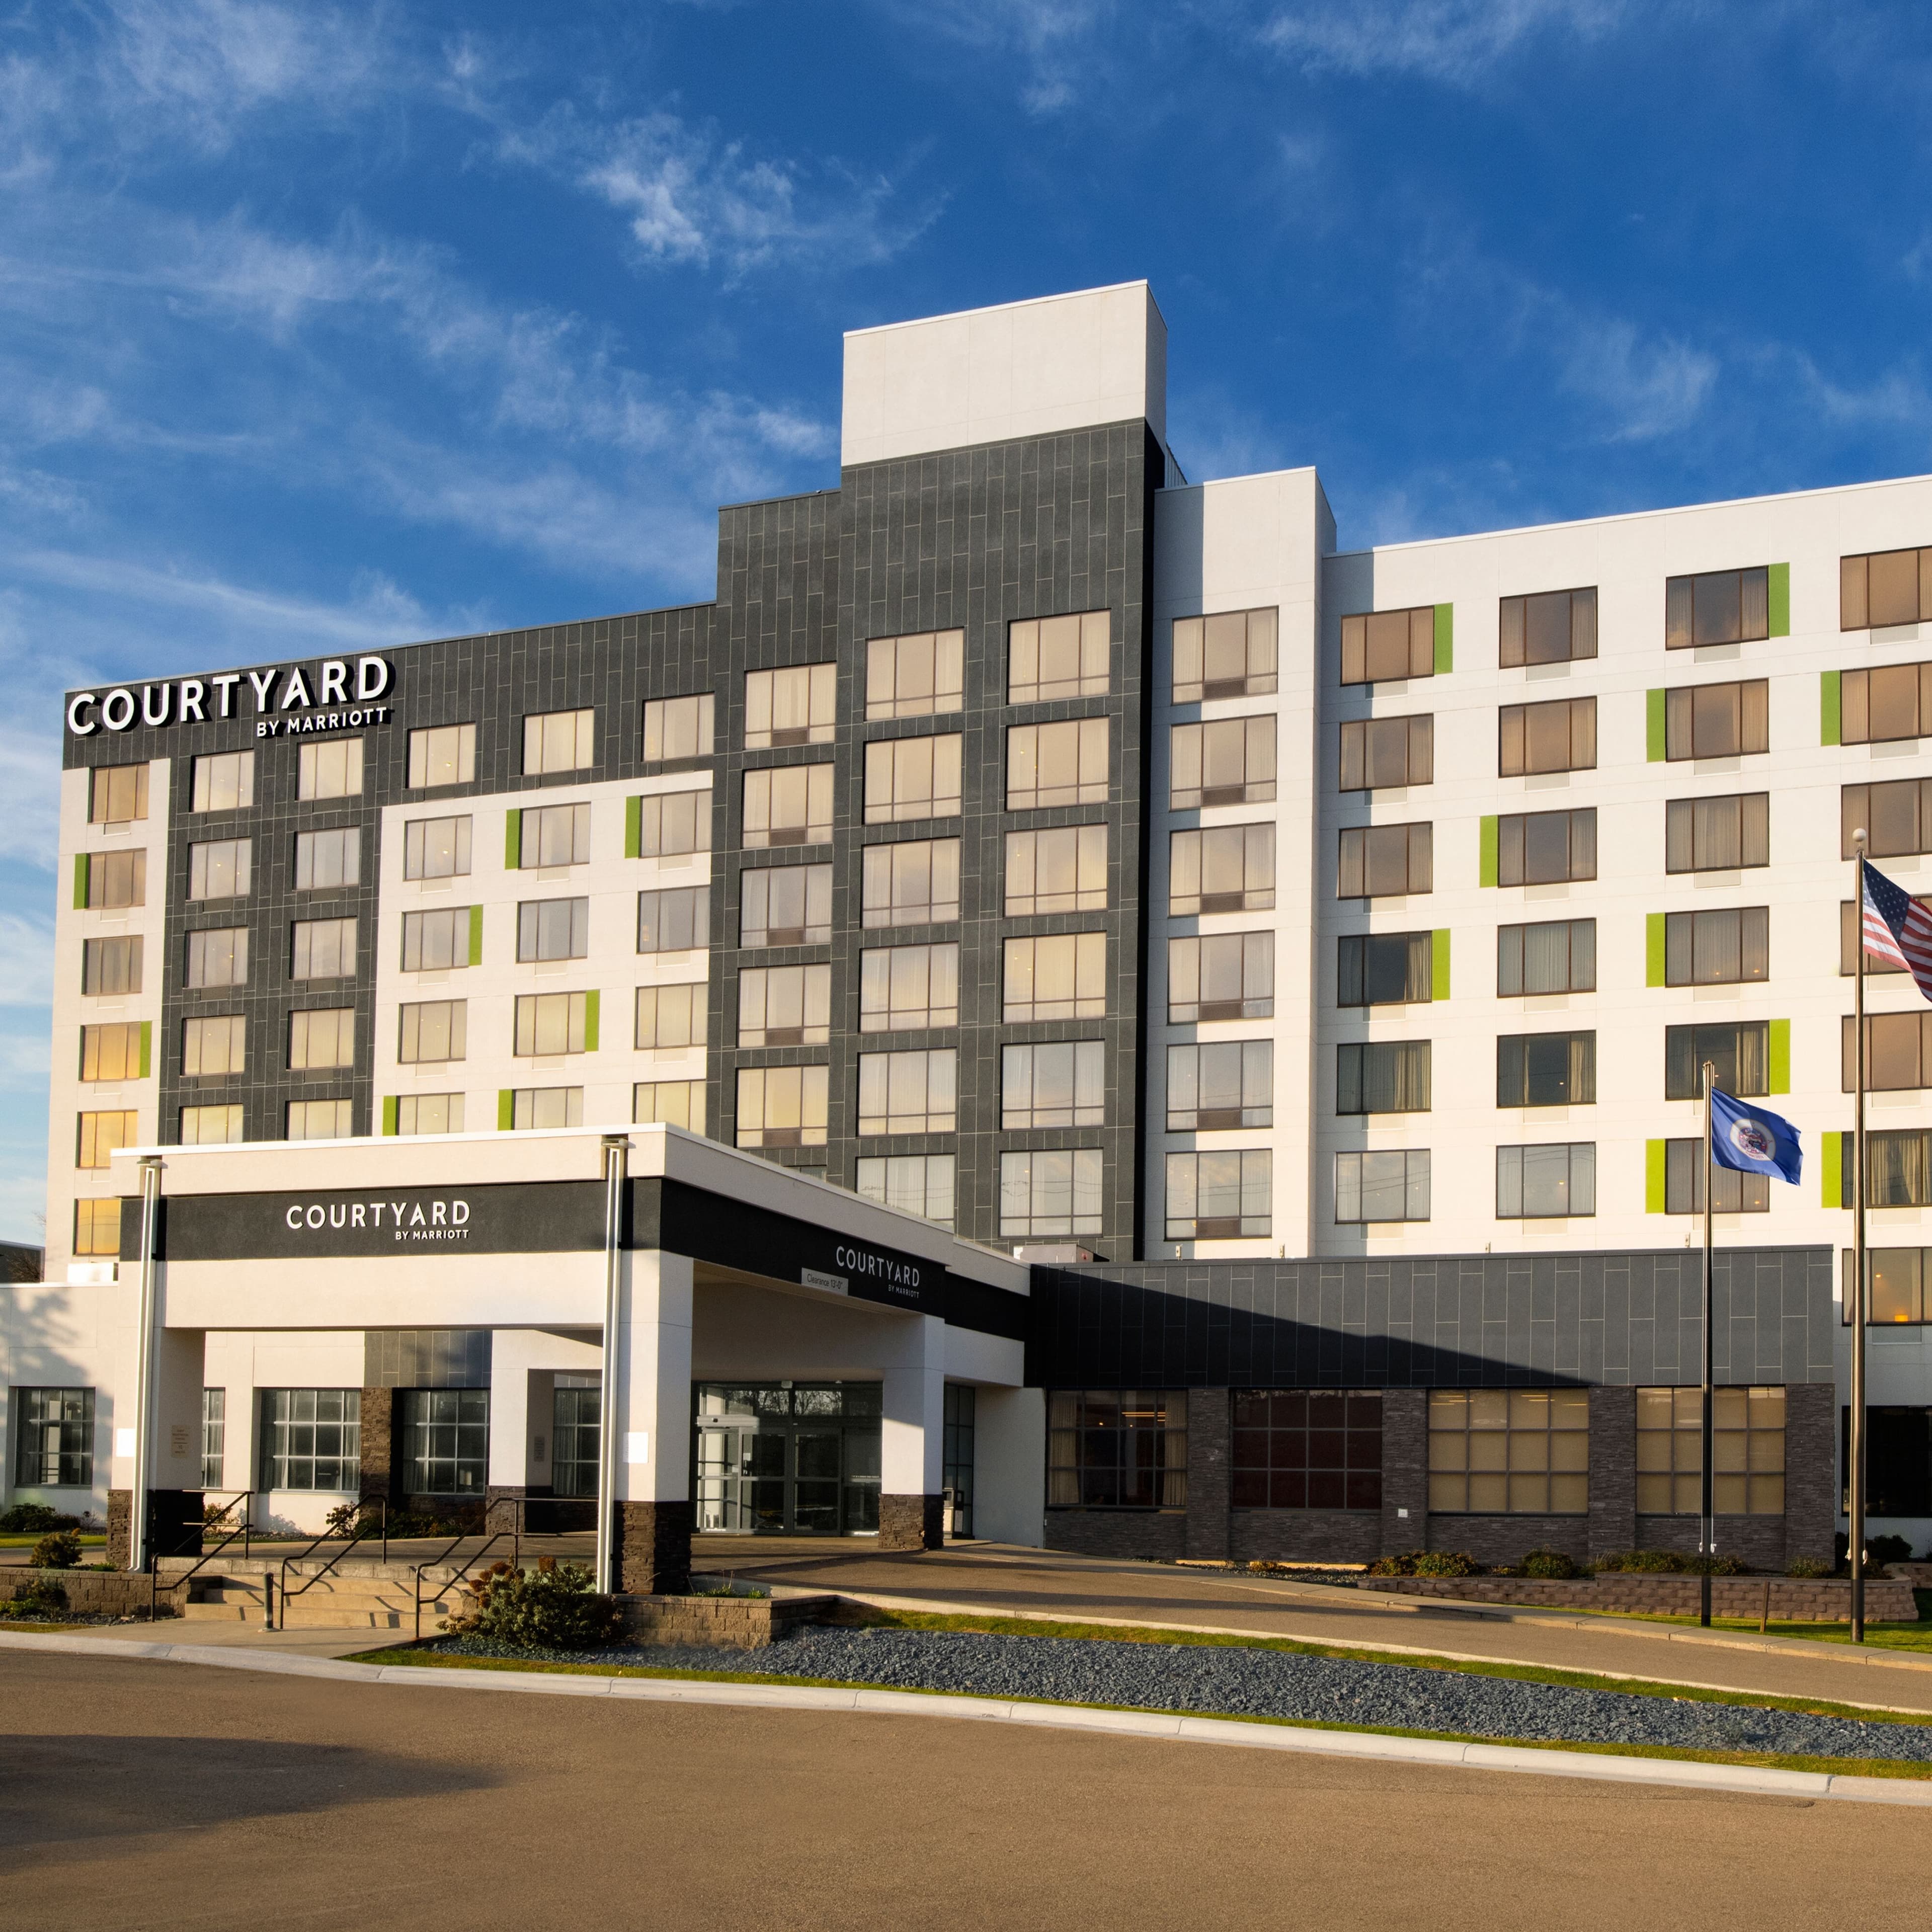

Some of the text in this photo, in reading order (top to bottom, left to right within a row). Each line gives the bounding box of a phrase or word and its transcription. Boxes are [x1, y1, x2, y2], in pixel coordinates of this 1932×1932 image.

[68, 656, 388, 735] COURTYARD
[257, 706, 387, 737] BY MARRIOTT
[286, 1200, 470, 1229] COURTYARD
[395, 1229, 469, 1240] BY MARRIOTT
[807, 1273, 830, 1286] Clearance
[836, 1245, 920, 1287] COURTYARD
[888, 1284, 919, 1299] BY MARRIOTT
